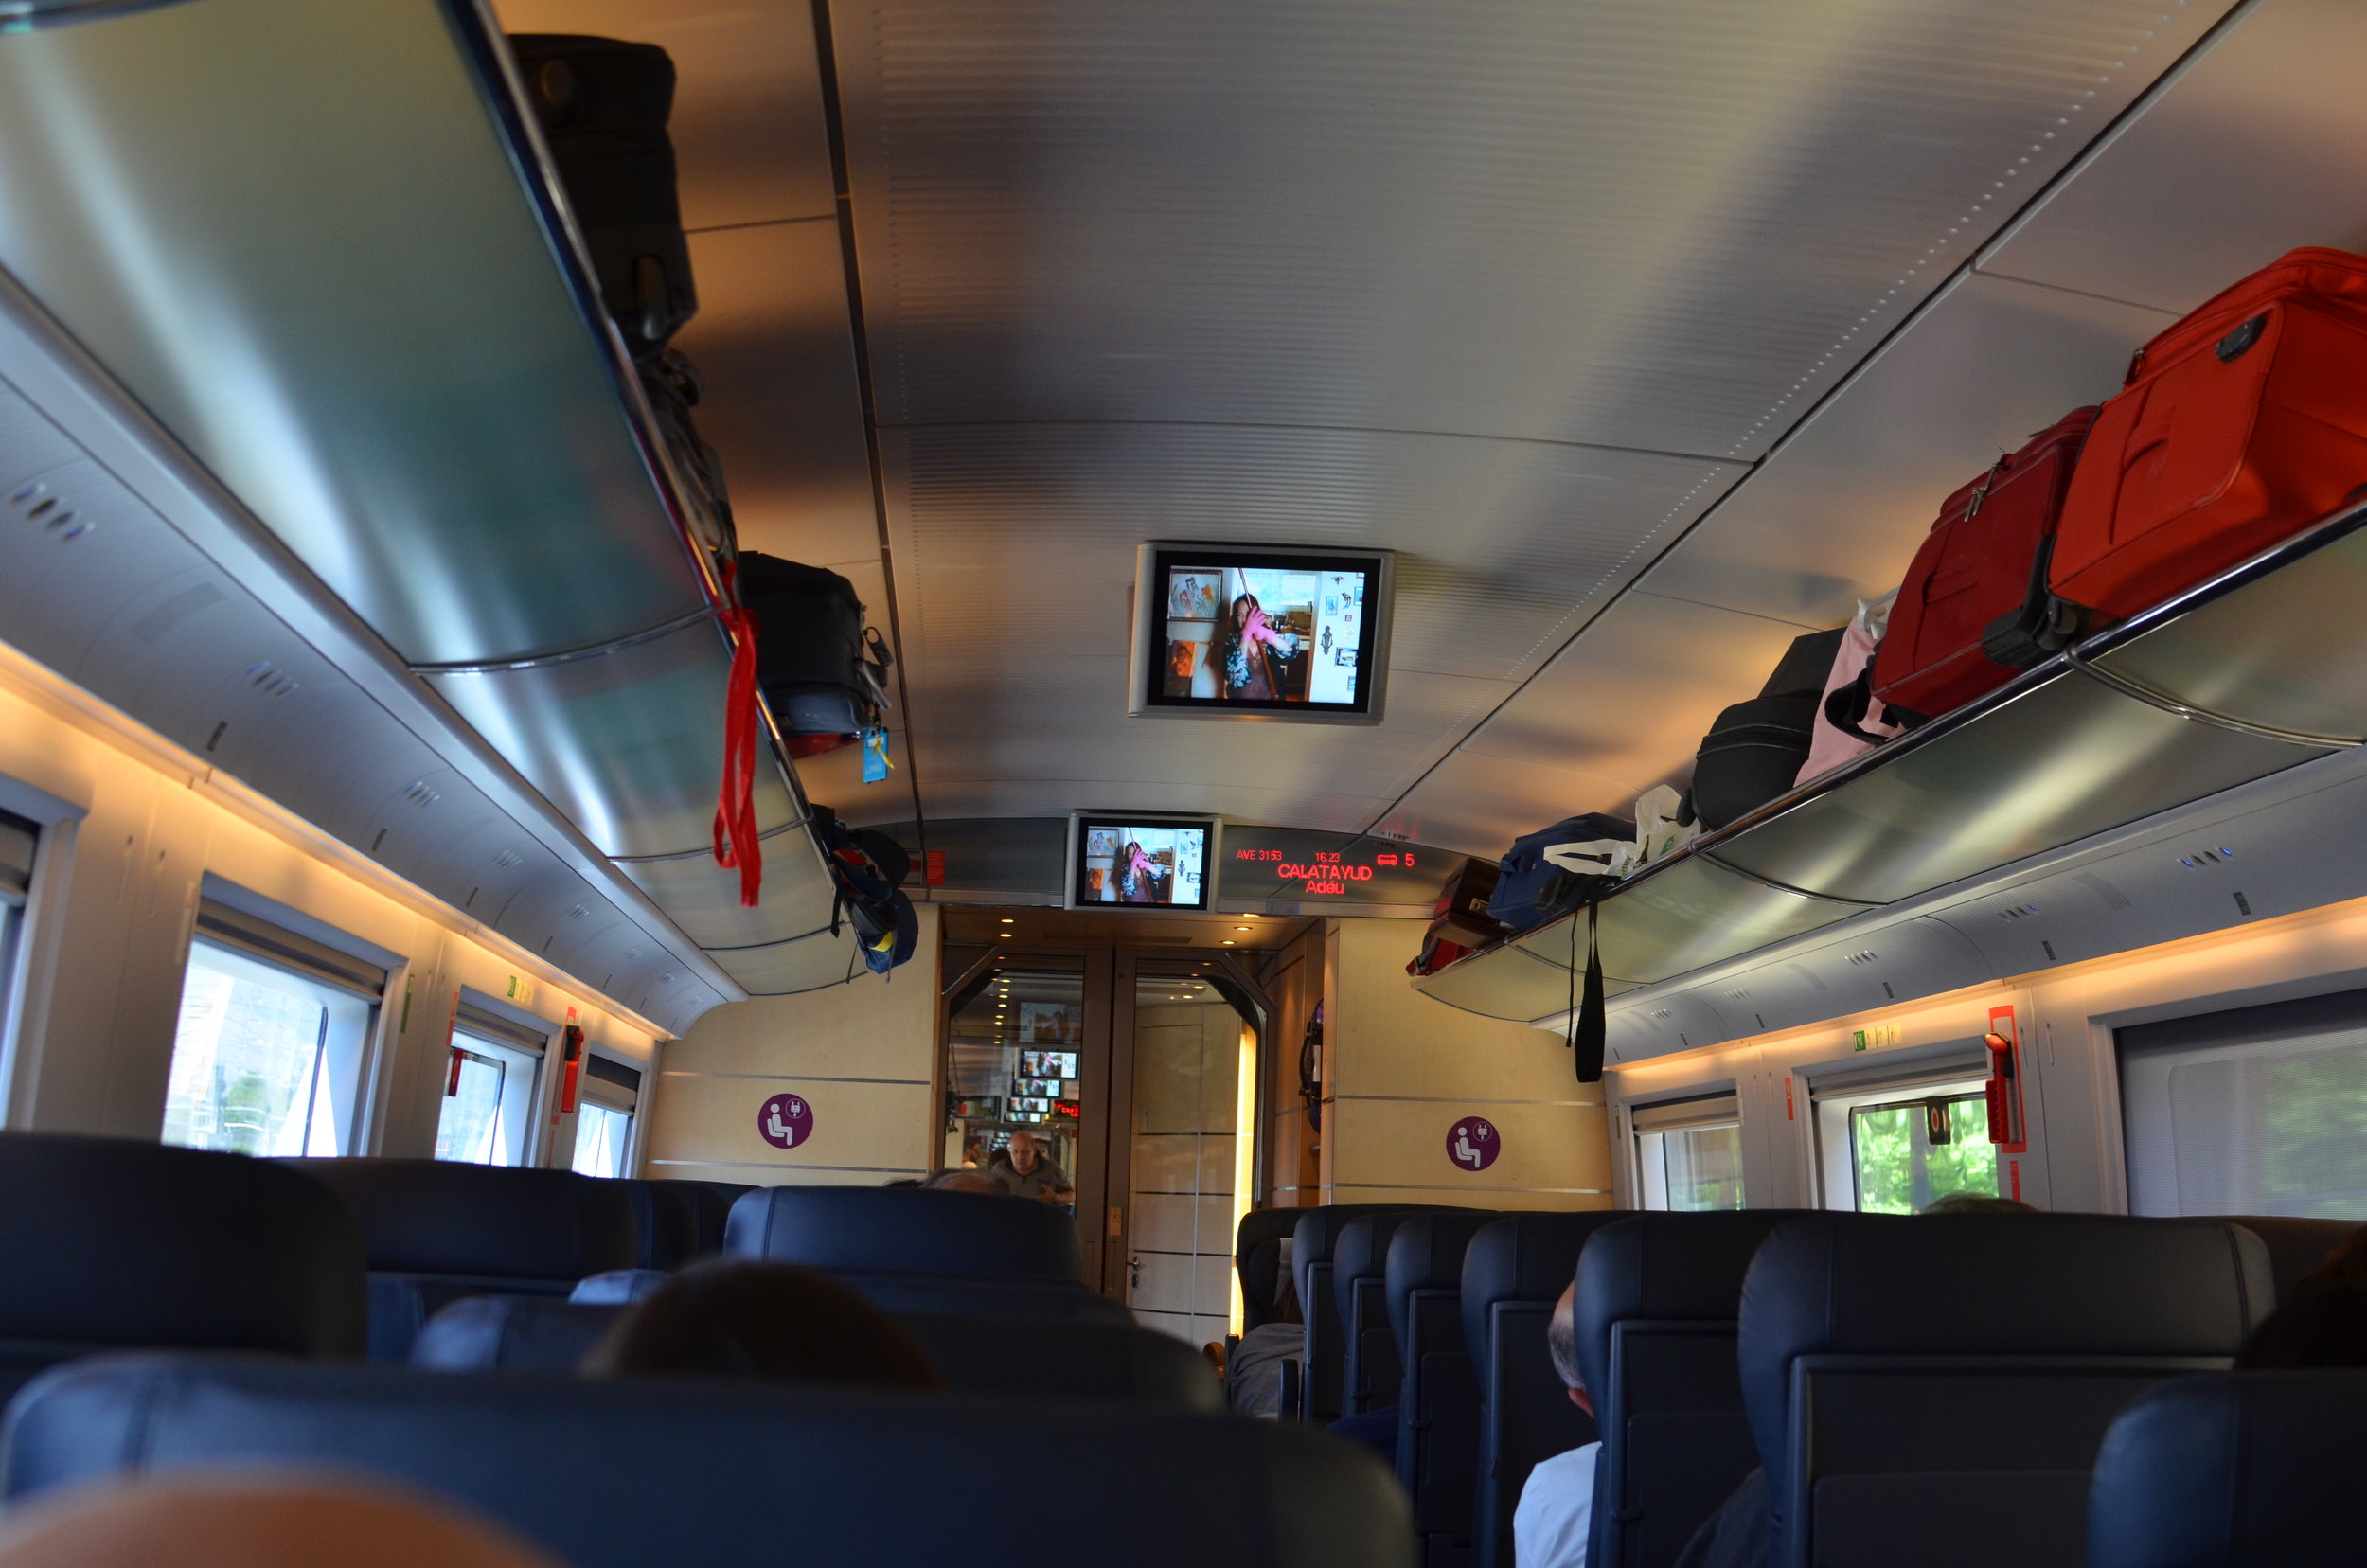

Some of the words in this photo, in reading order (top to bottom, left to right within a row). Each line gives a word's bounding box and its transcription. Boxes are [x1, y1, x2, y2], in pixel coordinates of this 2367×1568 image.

[1236, 849, 1256, 861] AVE
[1404, 851, 1415, 868] 5
[1277, 863, 1373, 881] CALATAYUD
[1306, 880, 1344, 895] Adéu
